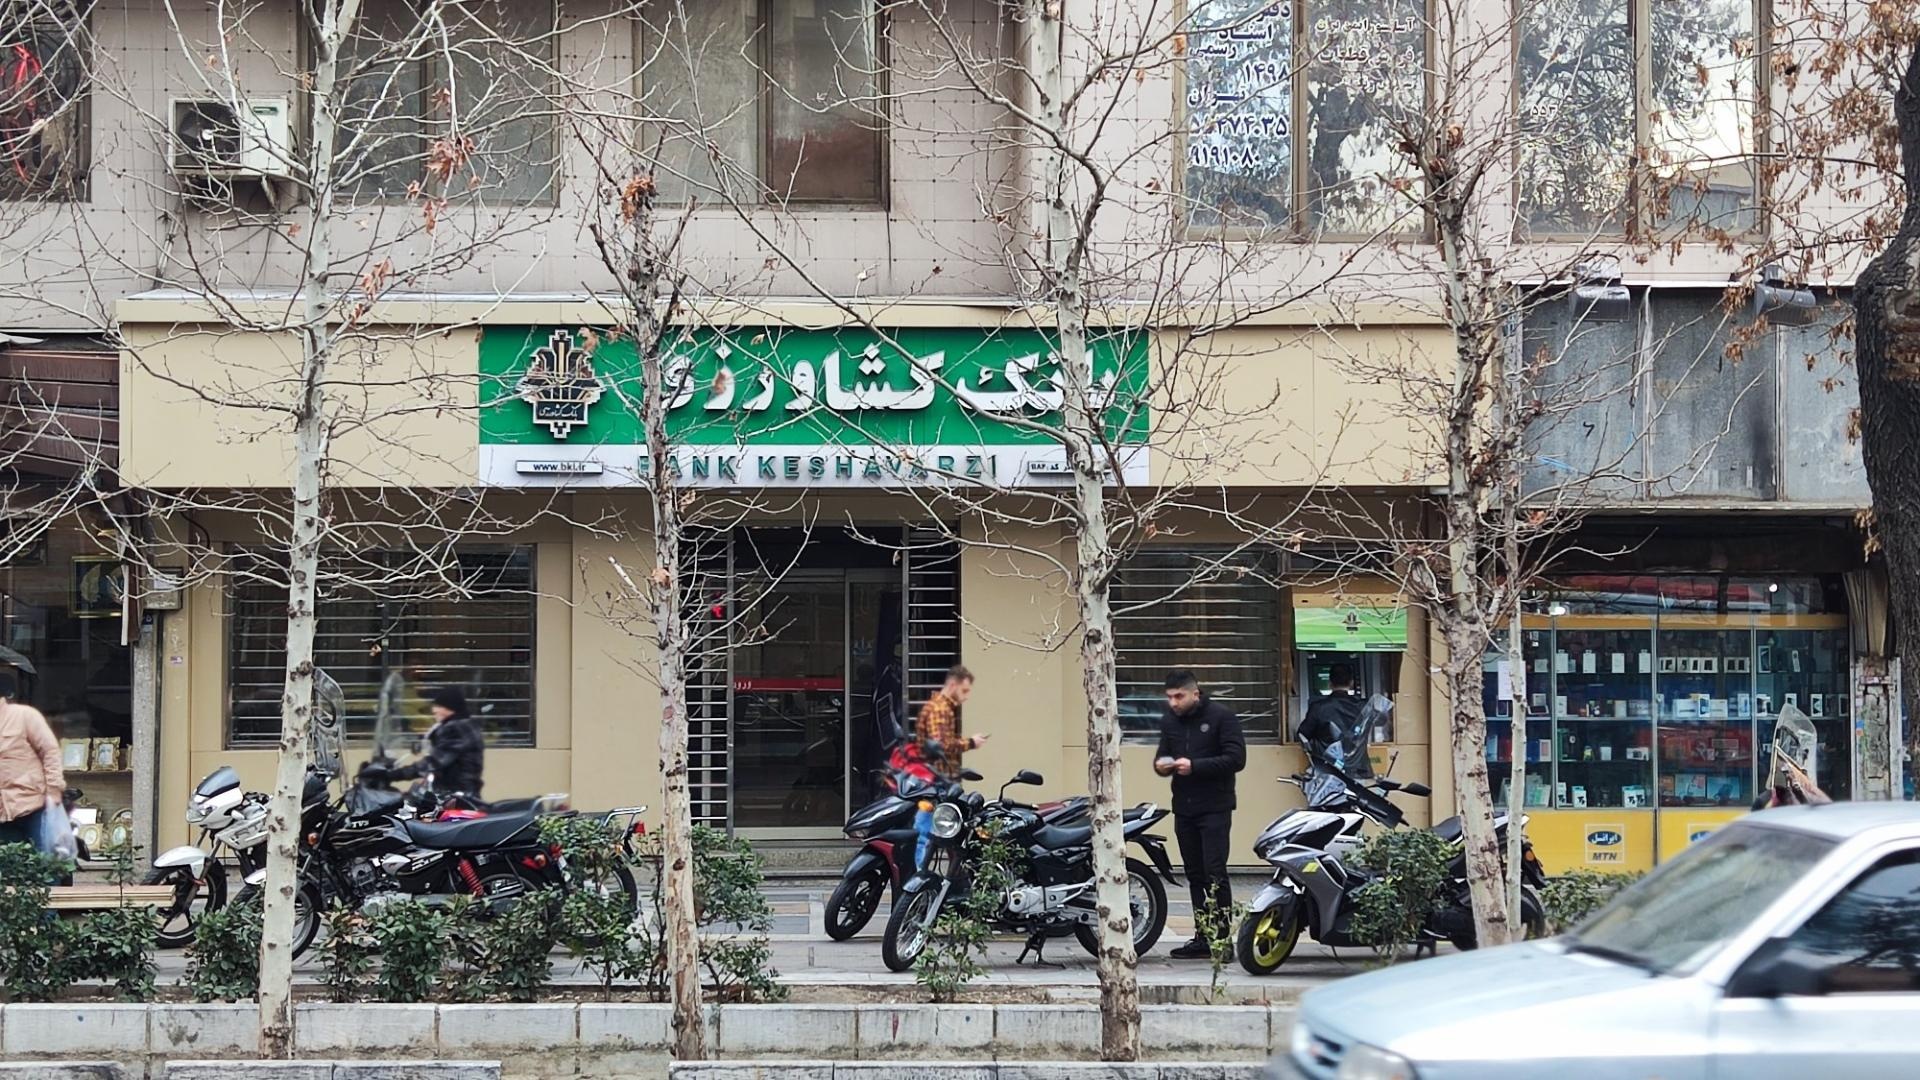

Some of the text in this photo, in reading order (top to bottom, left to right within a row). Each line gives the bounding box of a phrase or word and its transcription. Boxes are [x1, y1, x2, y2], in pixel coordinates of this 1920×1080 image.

[1218, 23, 1274, 41] اسناد
[1188, 43, 1238, 60] رسمی
[1367, 45, 1415, 69] فرش
[1244, 61, 1290, 82] ۱۴۹۸
[1188, 86, 1246, 107] تهران
[661, 342, 945, 411] کشاورزی
[757, 455, 997, 479] KESHAVARZI
[1592, 852, 1618, 861] MTN
